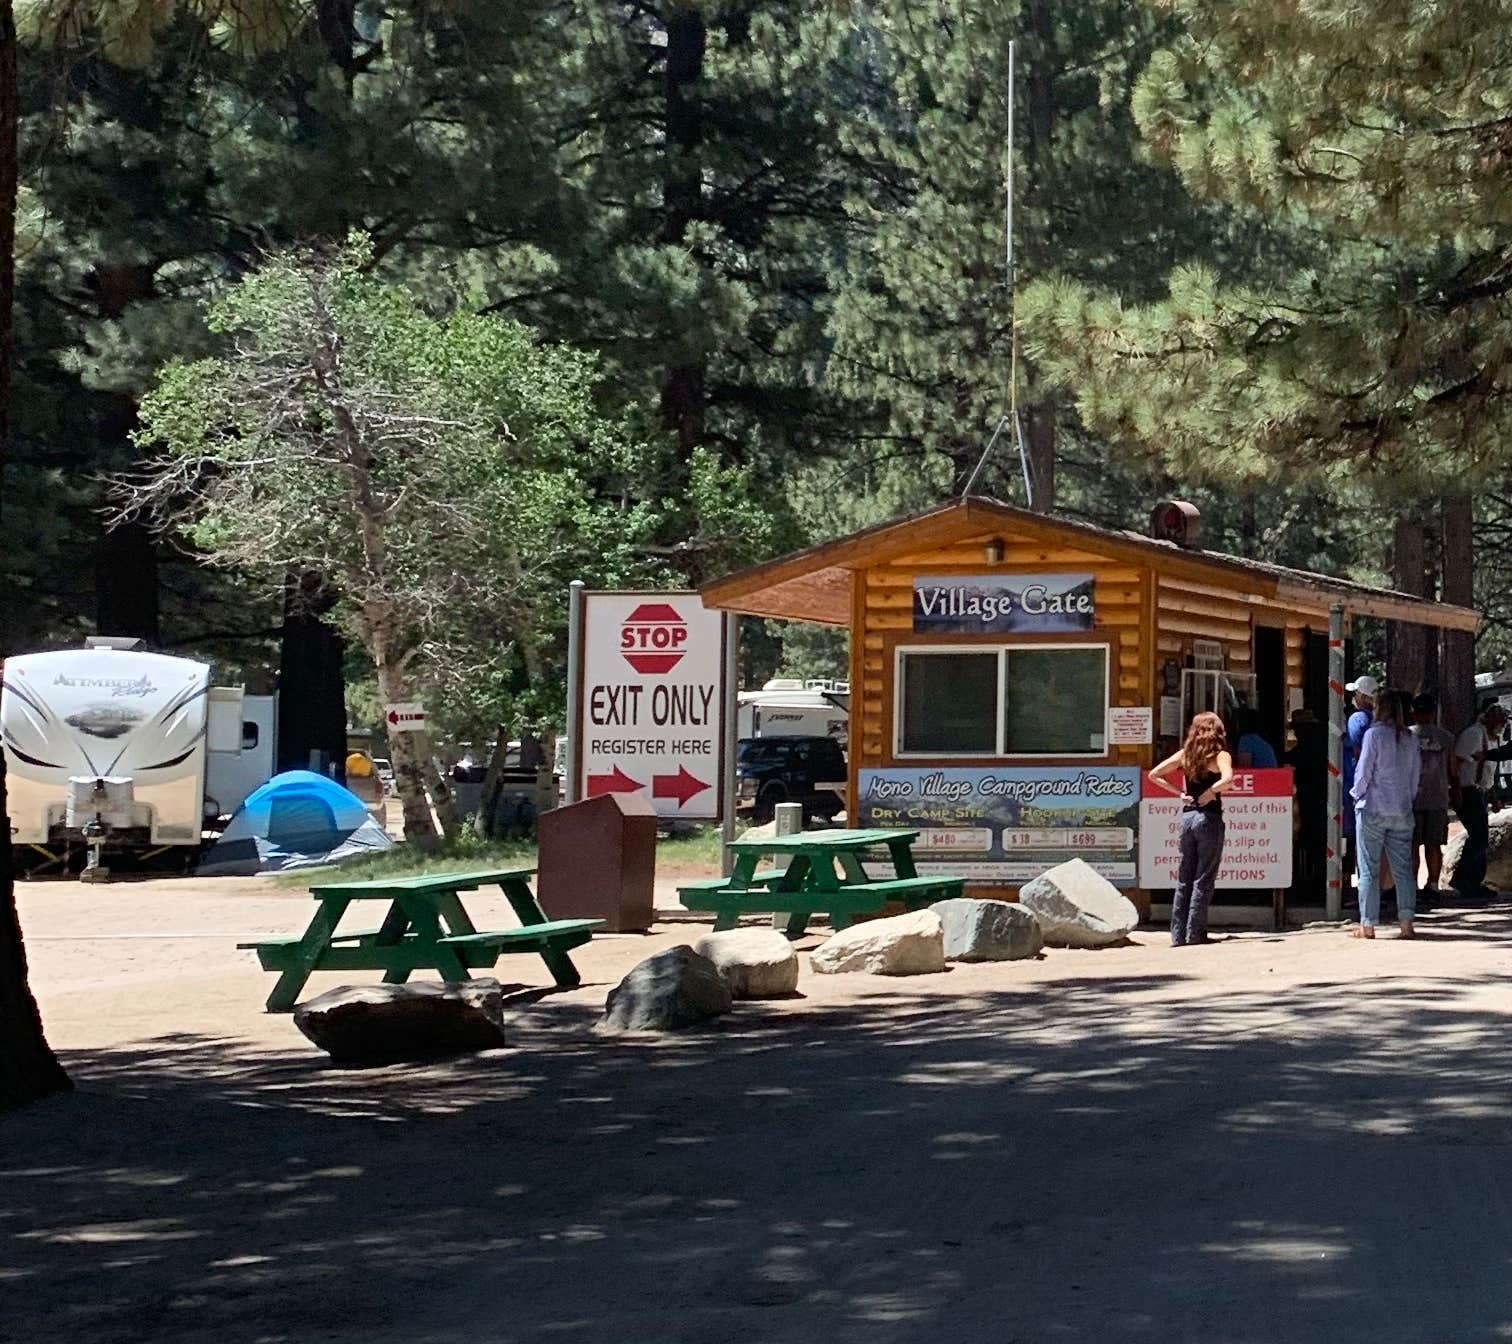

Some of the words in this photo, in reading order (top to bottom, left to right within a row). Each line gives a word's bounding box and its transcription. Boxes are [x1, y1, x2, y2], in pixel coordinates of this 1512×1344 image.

[916, 587, 1012, 622] Village
[621, 627, 688, 648] STOP
[590, 685, 643, 726] EXIT
[652, 685, 715, 726] ONLY
[591, 739, 666, 754] REGISTER
[672, 739, 711, 754] HERE
[869, 777, 912, 799] Mono
[920, 773, 972, 802] Village
[978, 772, 1082, 803] Campground
[1083, 773, 1134, 797] Rates
[872, 807, 902, 818] DRY
[908, 807, 949, 818] CAMP
[955, 806, 985, 818] SITE
[1149, 803, 1179, 816] Every
[1229, 804, 1248, 814] out
[1251, 803, 1263, 814] of
[1267, 803, 1287, 814] this
[1229, 820, 1257, 831] have
[1260, 822, 1266, 831] a
[1235, 836, 1255, 849] slip
[1258, 838, 1271, 847] or
